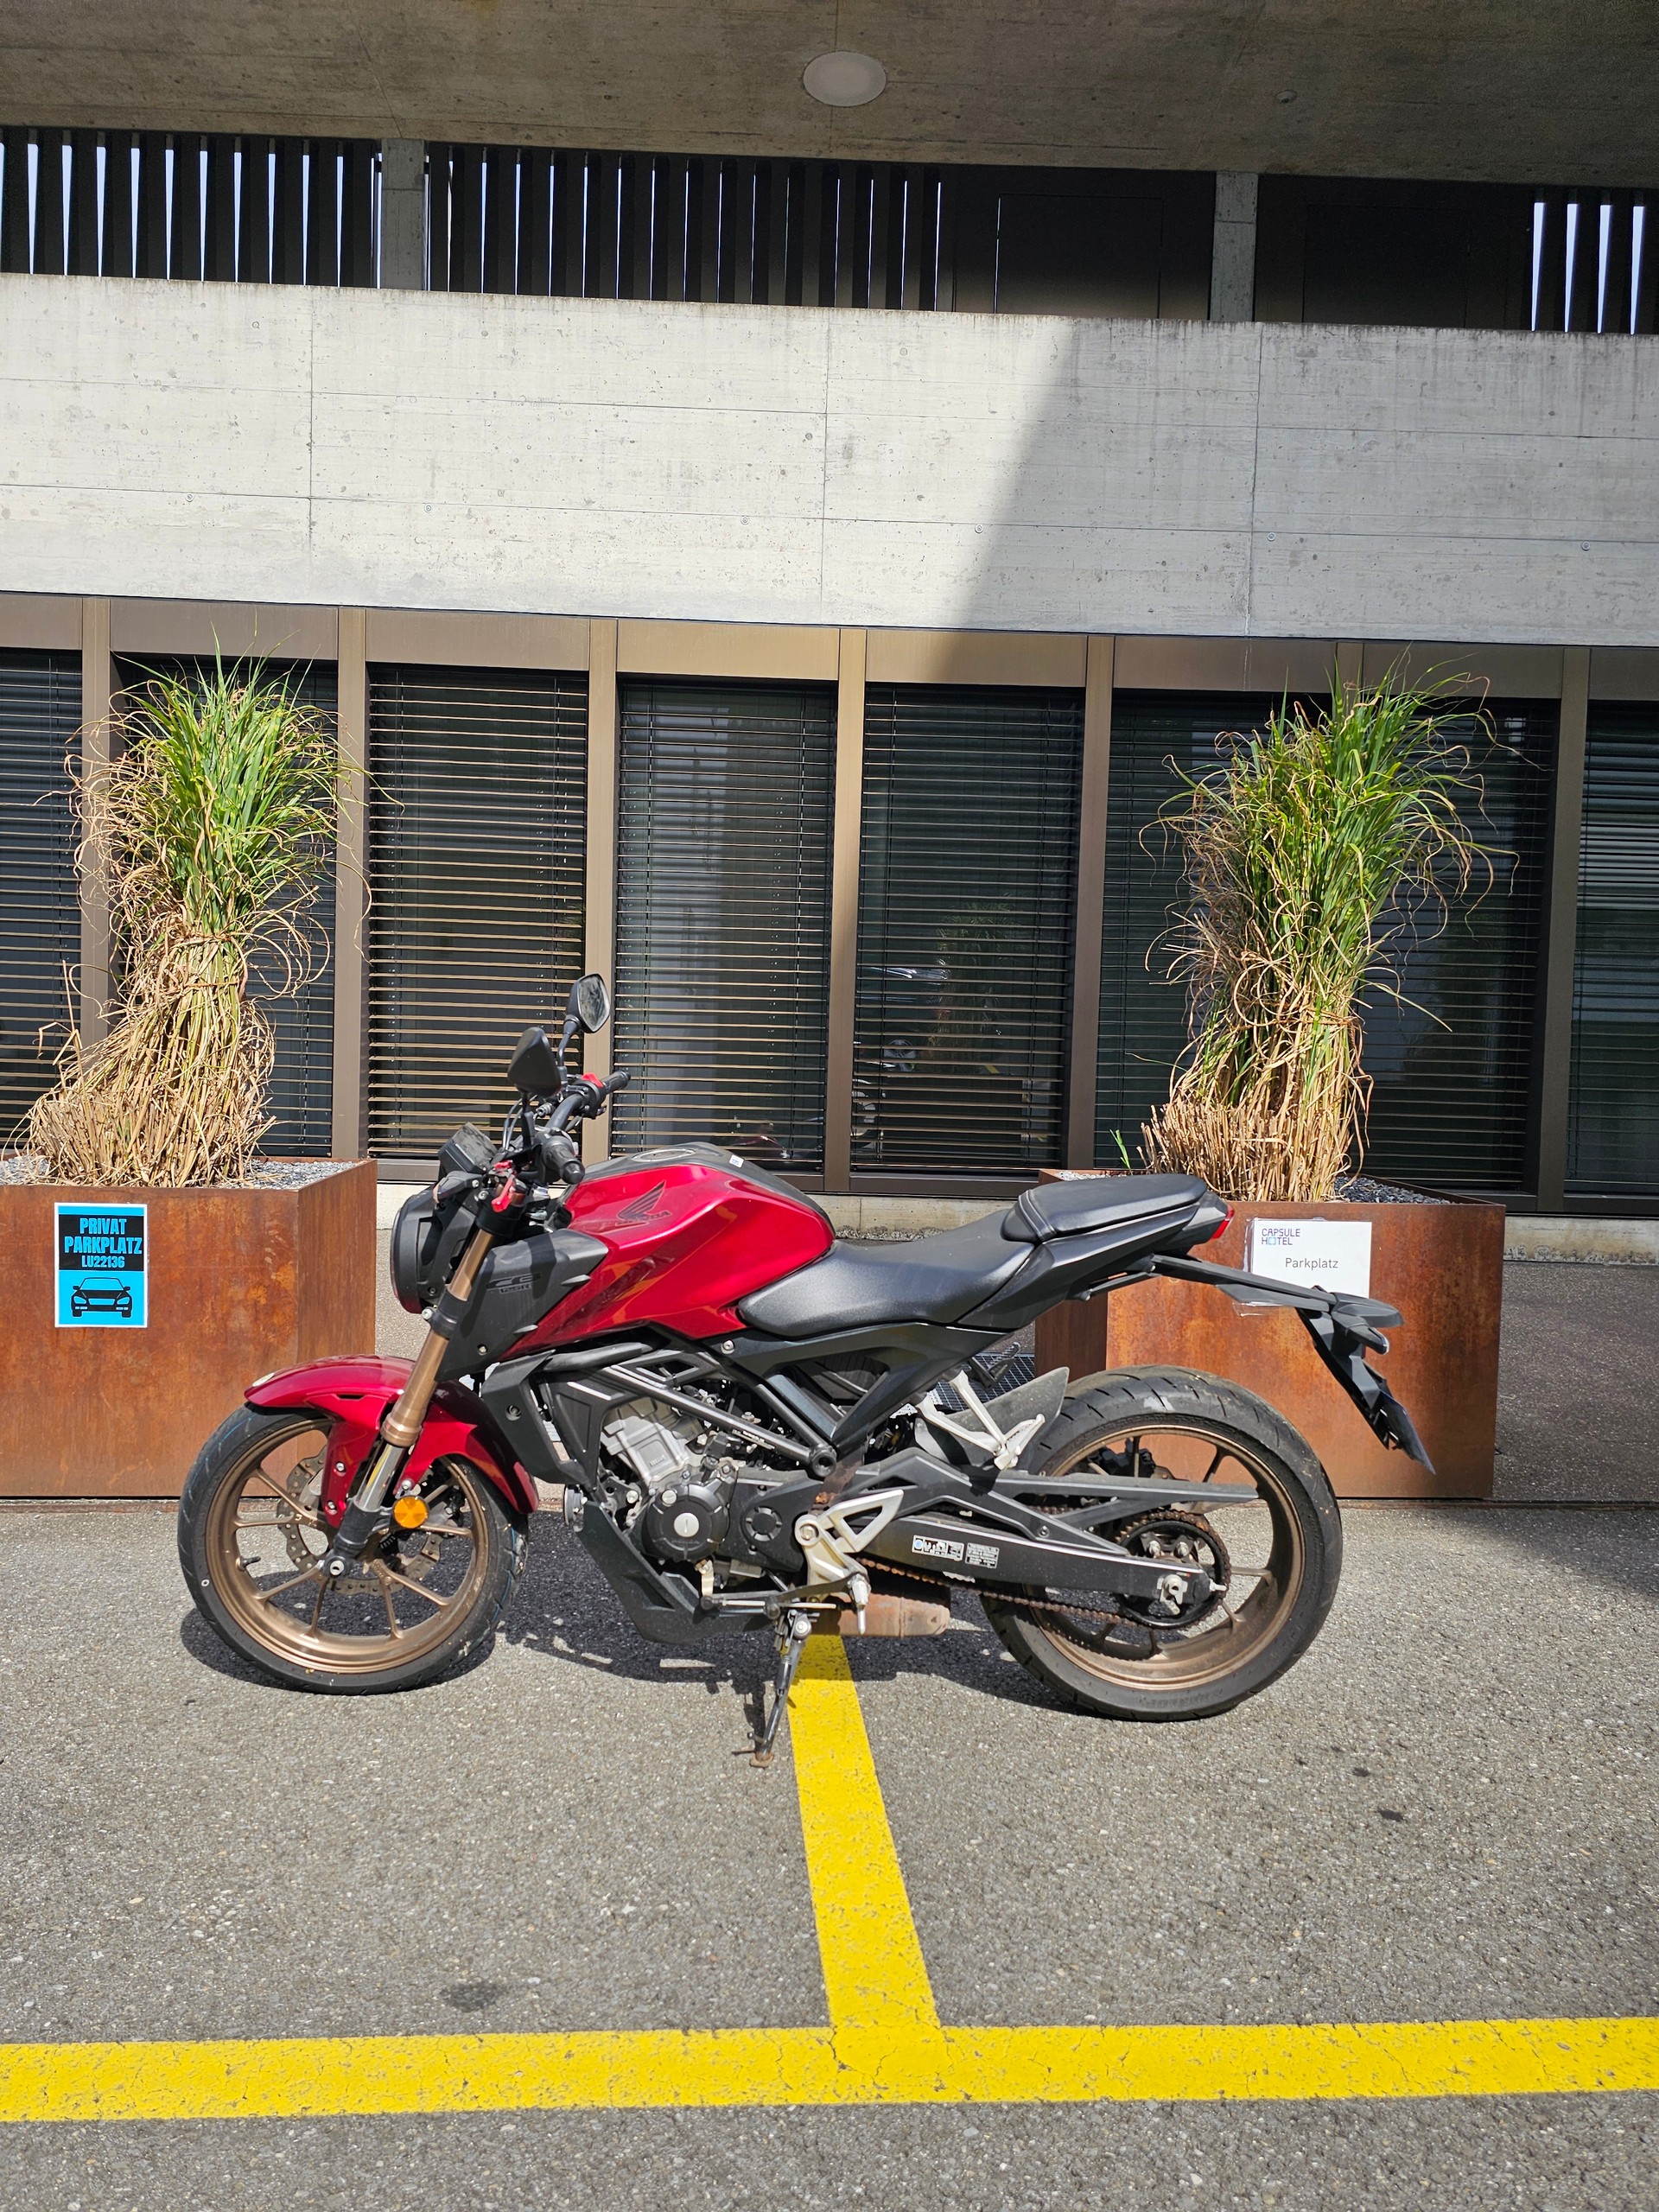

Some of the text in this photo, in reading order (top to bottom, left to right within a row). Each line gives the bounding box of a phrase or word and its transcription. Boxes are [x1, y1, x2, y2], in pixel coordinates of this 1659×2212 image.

[79, 1217, 127, 1235] PRIVAT
[1262, 1228, 1300, 1237] CAPSULE
[64, 1236, 143, 1255] PARKPLATZ
[81, 1255, 125, 1268] LU22136
[1285, 1257, 1338, 1270] Parkplatz
